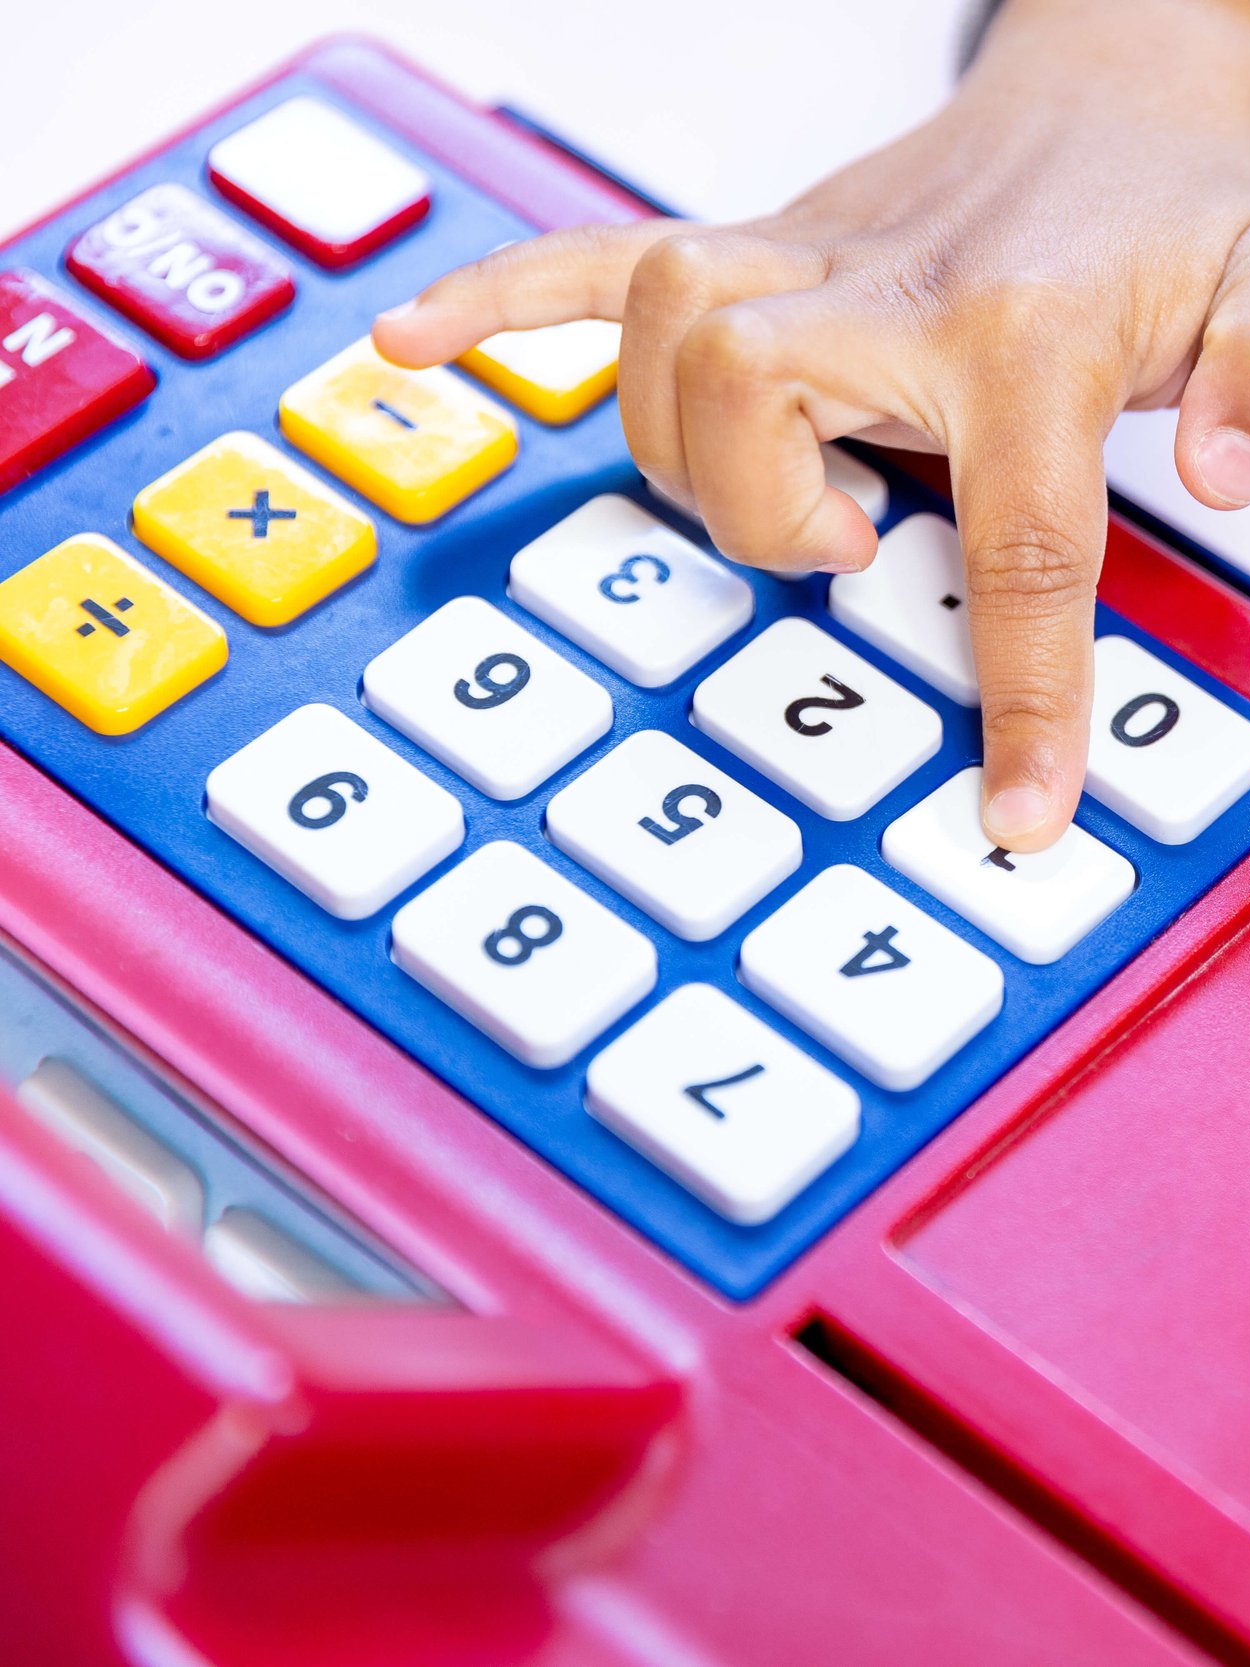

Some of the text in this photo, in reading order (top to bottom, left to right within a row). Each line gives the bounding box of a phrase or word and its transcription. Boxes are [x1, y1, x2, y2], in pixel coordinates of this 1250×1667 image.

[598, 553, 671, 605] 3
[453, 651, 532, 710] 6
[784, 672, 867, 737] 2
[287, 771, 369, 830] 9
[638, 782, 723, 846] 5
[483, 904, 564, 967] 8
[839, 925, 912, 978] 4
[684, 1064, 765, 1120] 7
